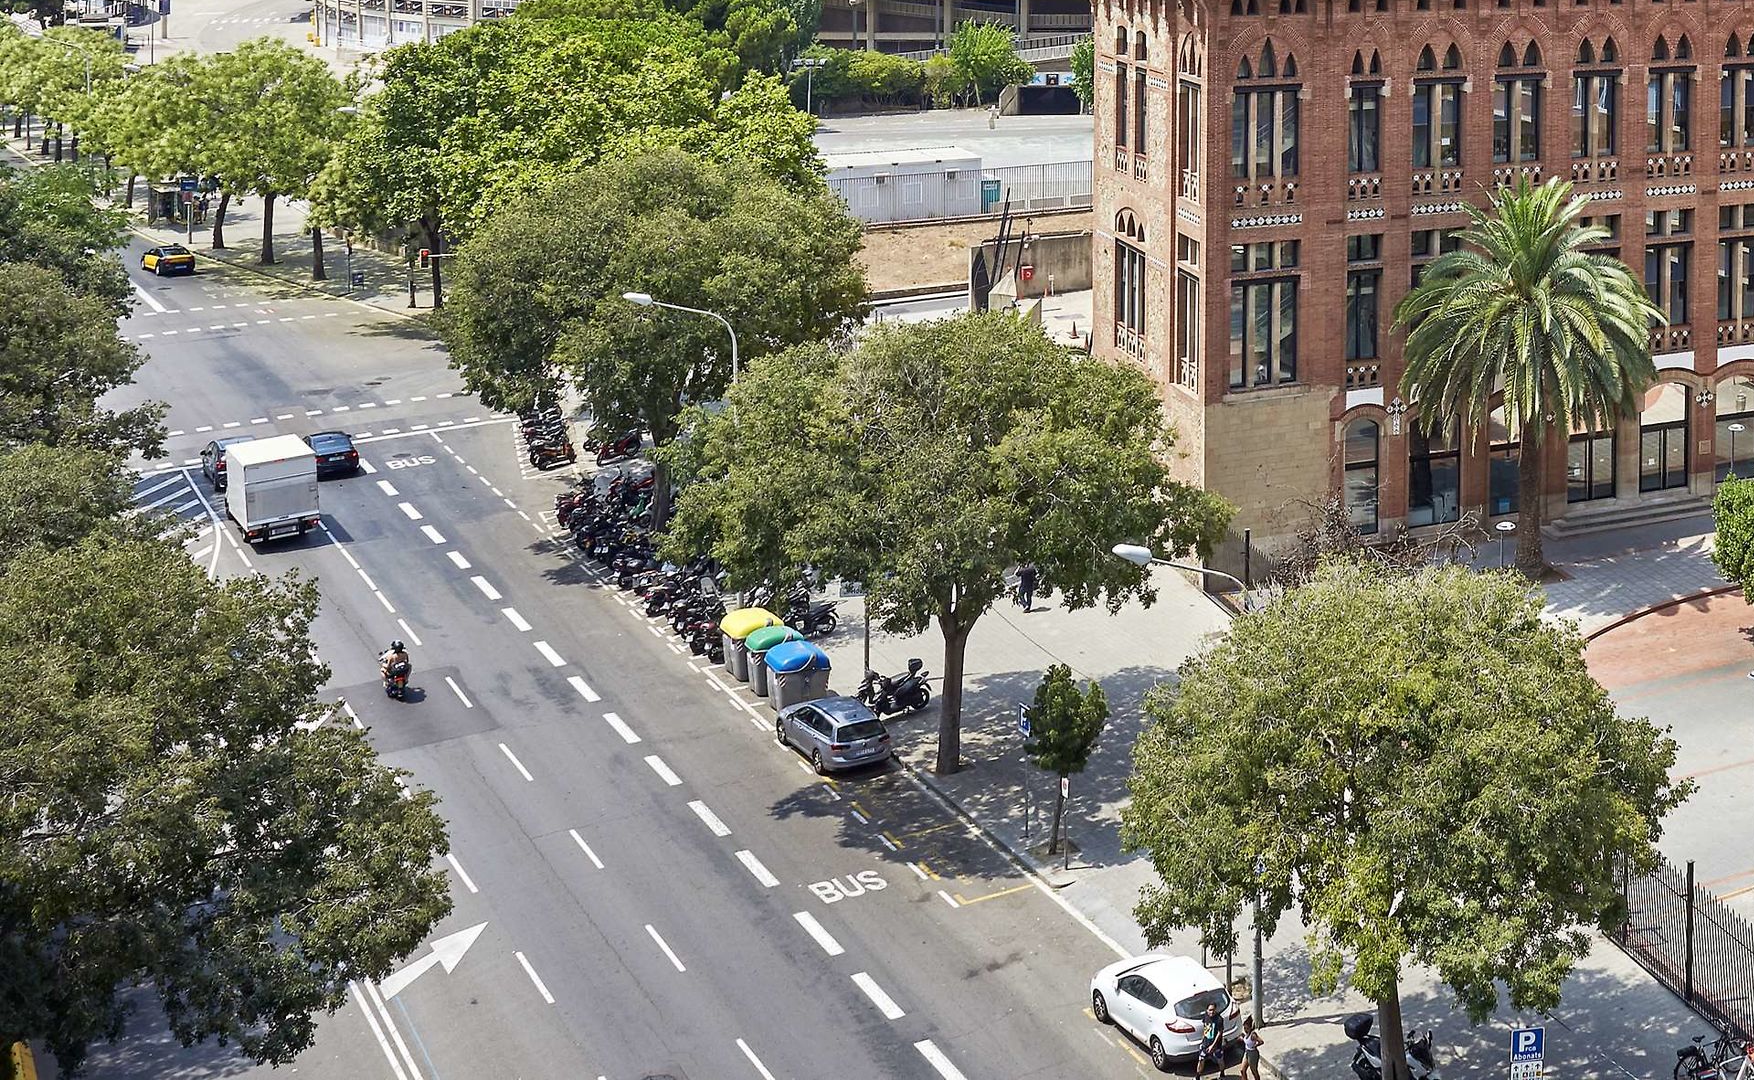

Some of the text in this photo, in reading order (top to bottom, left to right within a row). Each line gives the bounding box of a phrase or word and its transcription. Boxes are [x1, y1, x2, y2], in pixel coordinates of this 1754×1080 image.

[385, 455, 436, 470] BUS
[808, 870, 888, 904] BUS
[1518, 1031, 1536, 1052] P
[1513, 1052, 1541, 1061] Abonats
